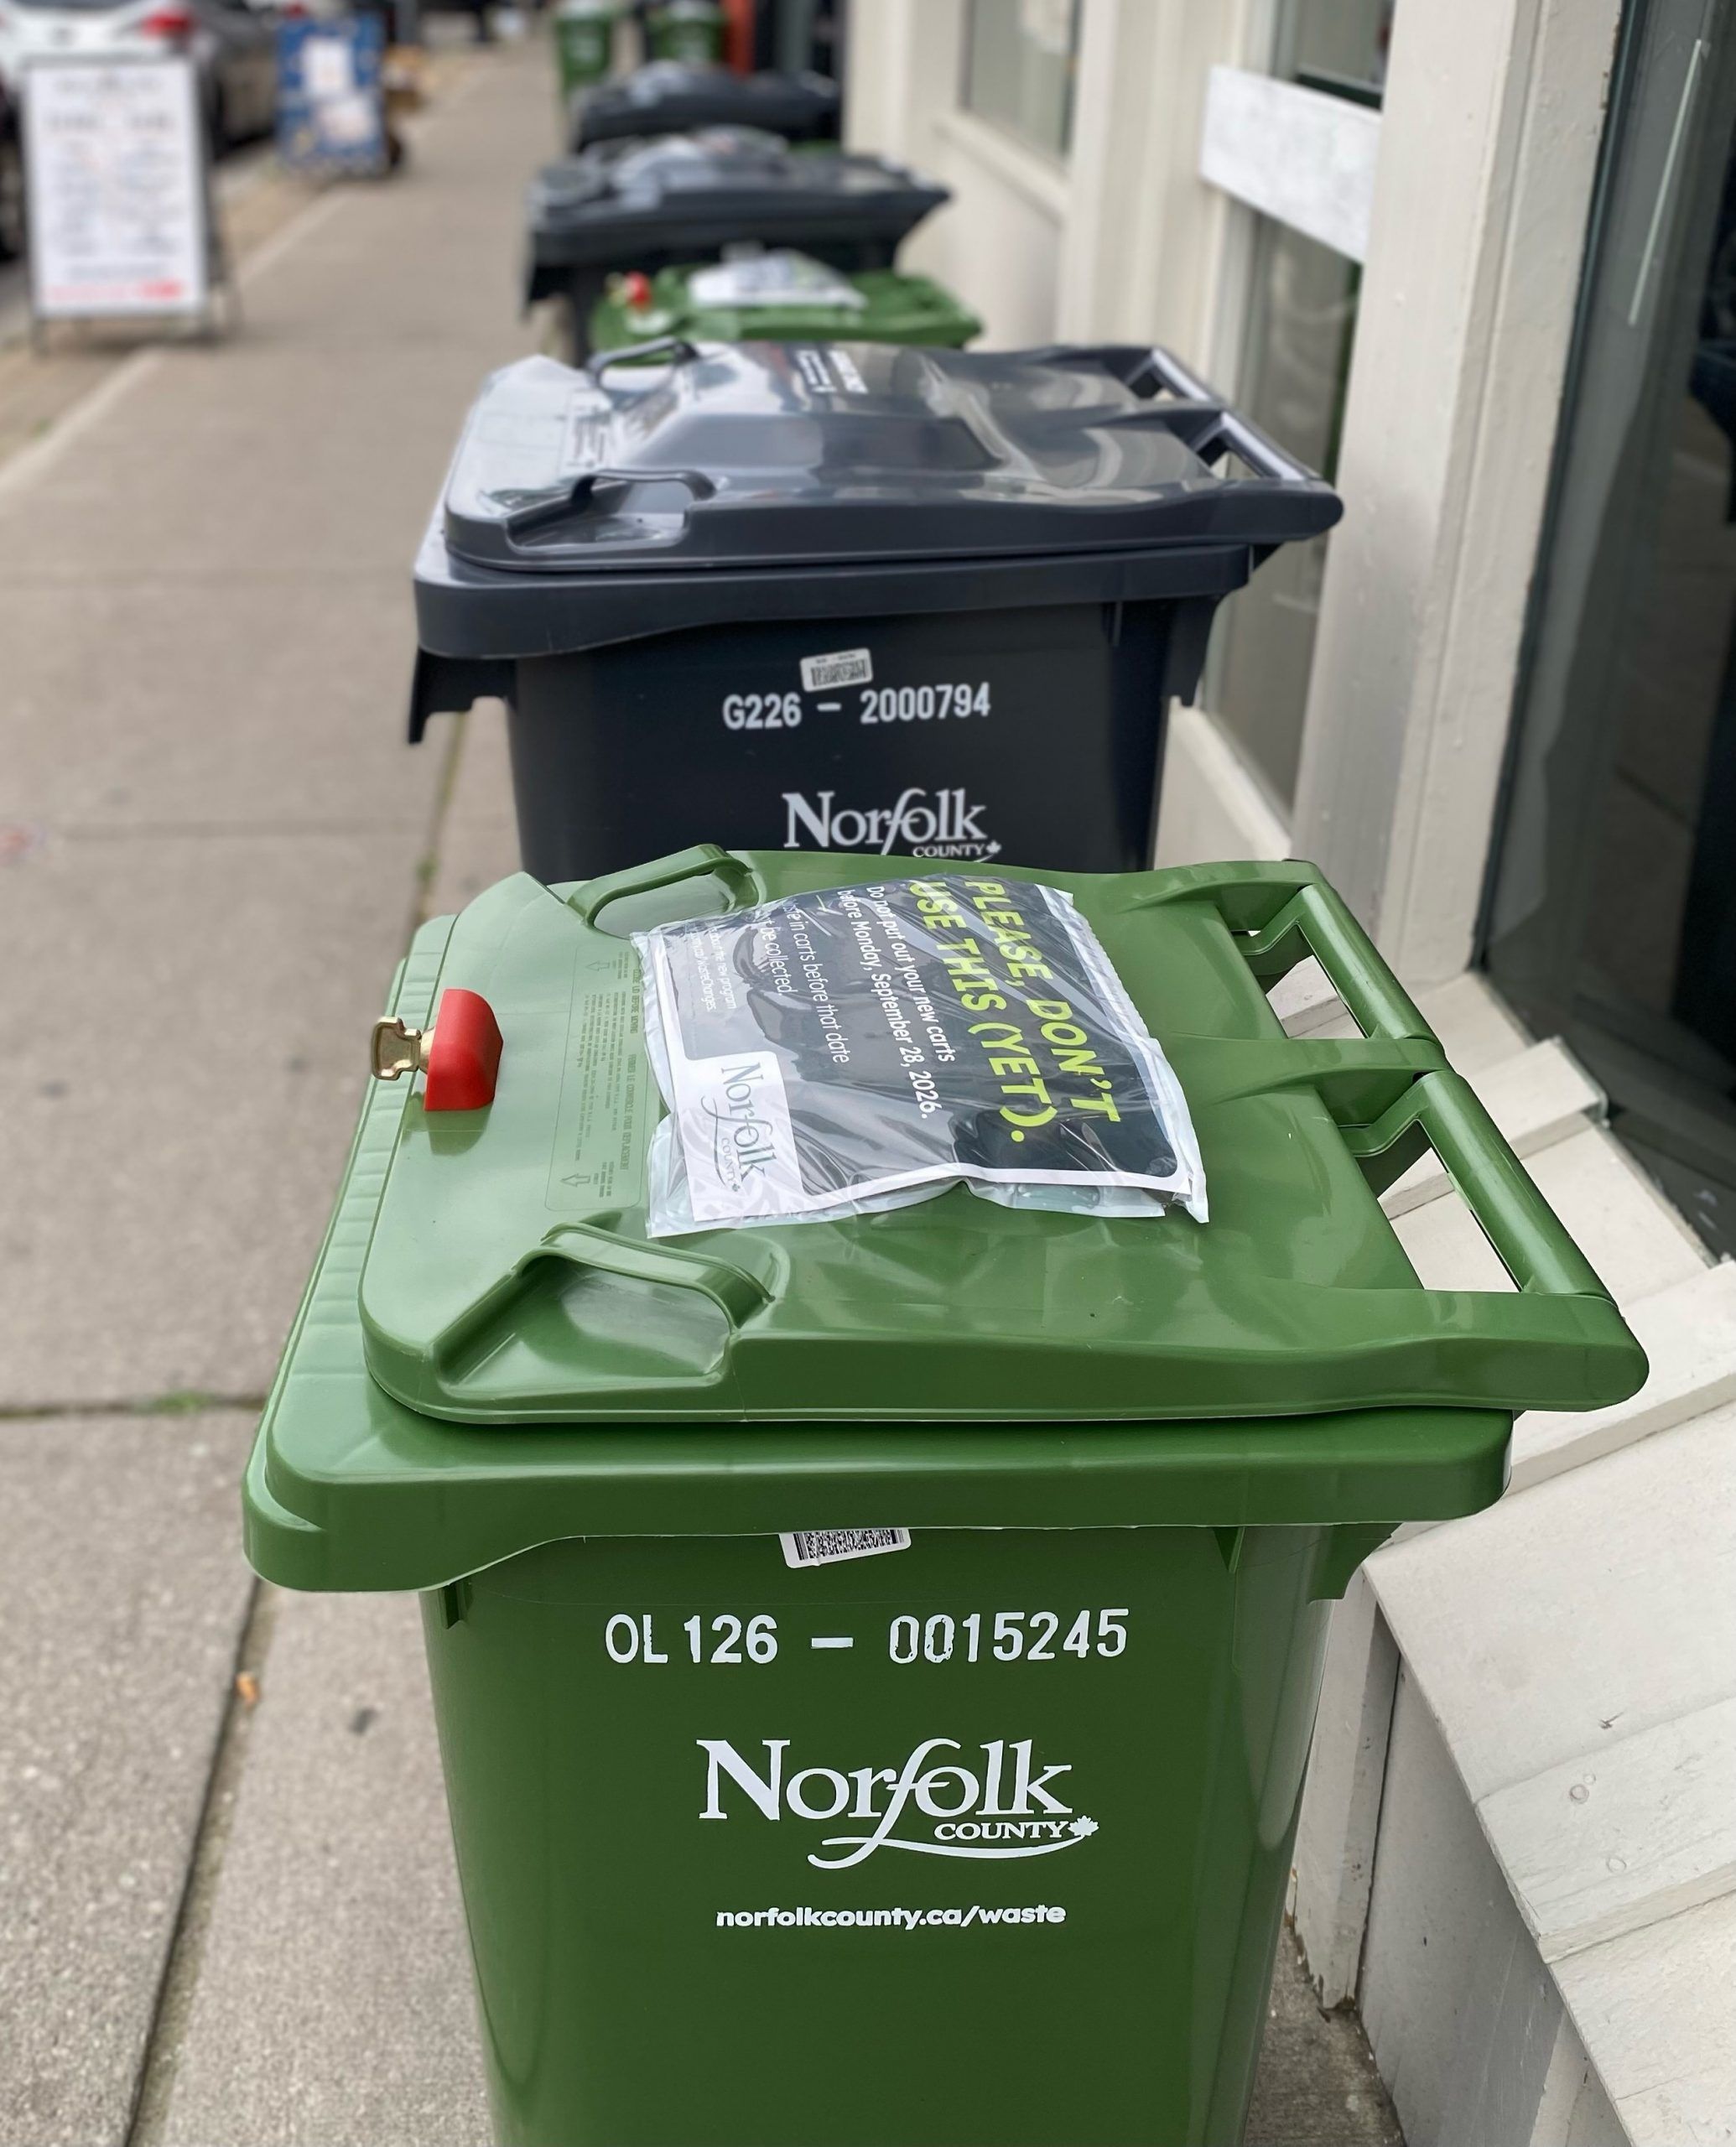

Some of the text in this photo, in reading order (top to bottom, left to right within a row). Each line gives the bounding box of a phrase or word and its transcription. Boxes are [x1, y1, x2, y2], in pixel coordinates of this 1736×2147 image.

[722, 692, 802, 730] G226
[860, 682, 991, 724] 2000794
[782, 788, 988, 855] Norfolk
[912, 843, 986, 858] COUNTY
[760, 927, 782, 941] be
[790, 921, 808, 931] in
[793, 933, 817, 961] carts
[718, 962, 728, 976] new
[765, 943, 797, 996] collected.
[802, 964, 829, 1001] before
[866, 886, 956, 1062] Do not put out your new carts
[718, 978, 737, 1009] program
[838, 889, 942, 1119] before Monday, September 28, 2026.
[909, 880, 1058, 1142] USE THIS (YET).
[965, 881, 1120, 1121] PLEASE, DON'T
[816, 1005, 843, 1030] that
[824, 1032, 850, 1063] date
[701, 1063, 777, 1185] Norfolk
[720, 1137, 735, 1184] COUNTY
[889, 1608, 1130, 1664] 0015245
[696, 1737, 1073, 1869] Norfolk
[933, 1821, 1068, 1840] COUNTY
[716, 1905, 1066, 1930] norfolkcounty.ca/waste
